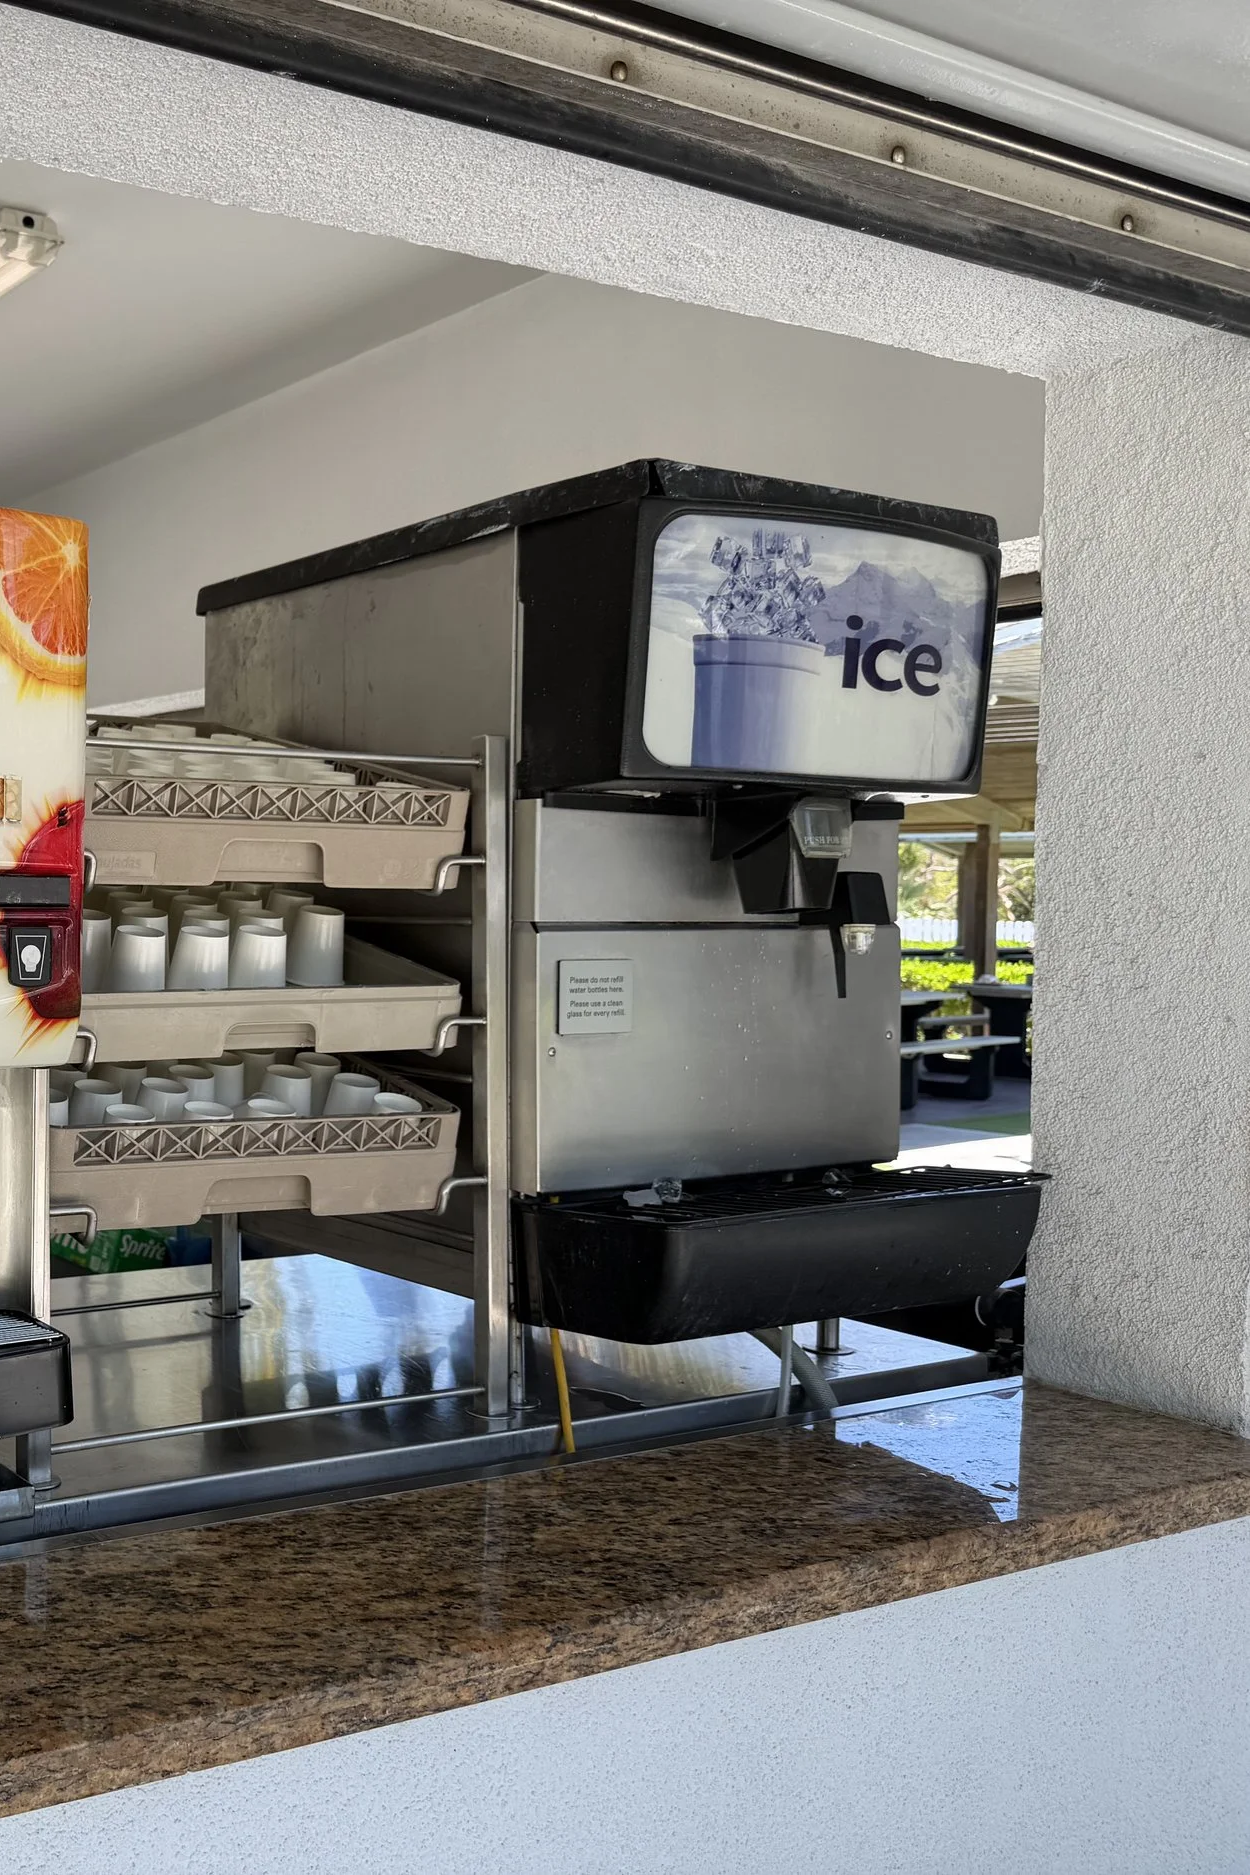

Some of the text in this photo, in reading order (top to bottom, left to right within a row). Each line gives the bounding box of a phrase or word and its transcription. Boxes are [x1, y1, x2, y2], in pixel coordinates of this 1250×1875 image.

[842, 615, 942, 696] ice
[569, 976, 589, 984] Please
[590, 976, 599, 984] do
[610, 975, 624, 983] refill
[566, 1011, 583, 1019] glass
[592, 1010, 610, 1019] every
[119, 1234, 166, 1260] Sprite
